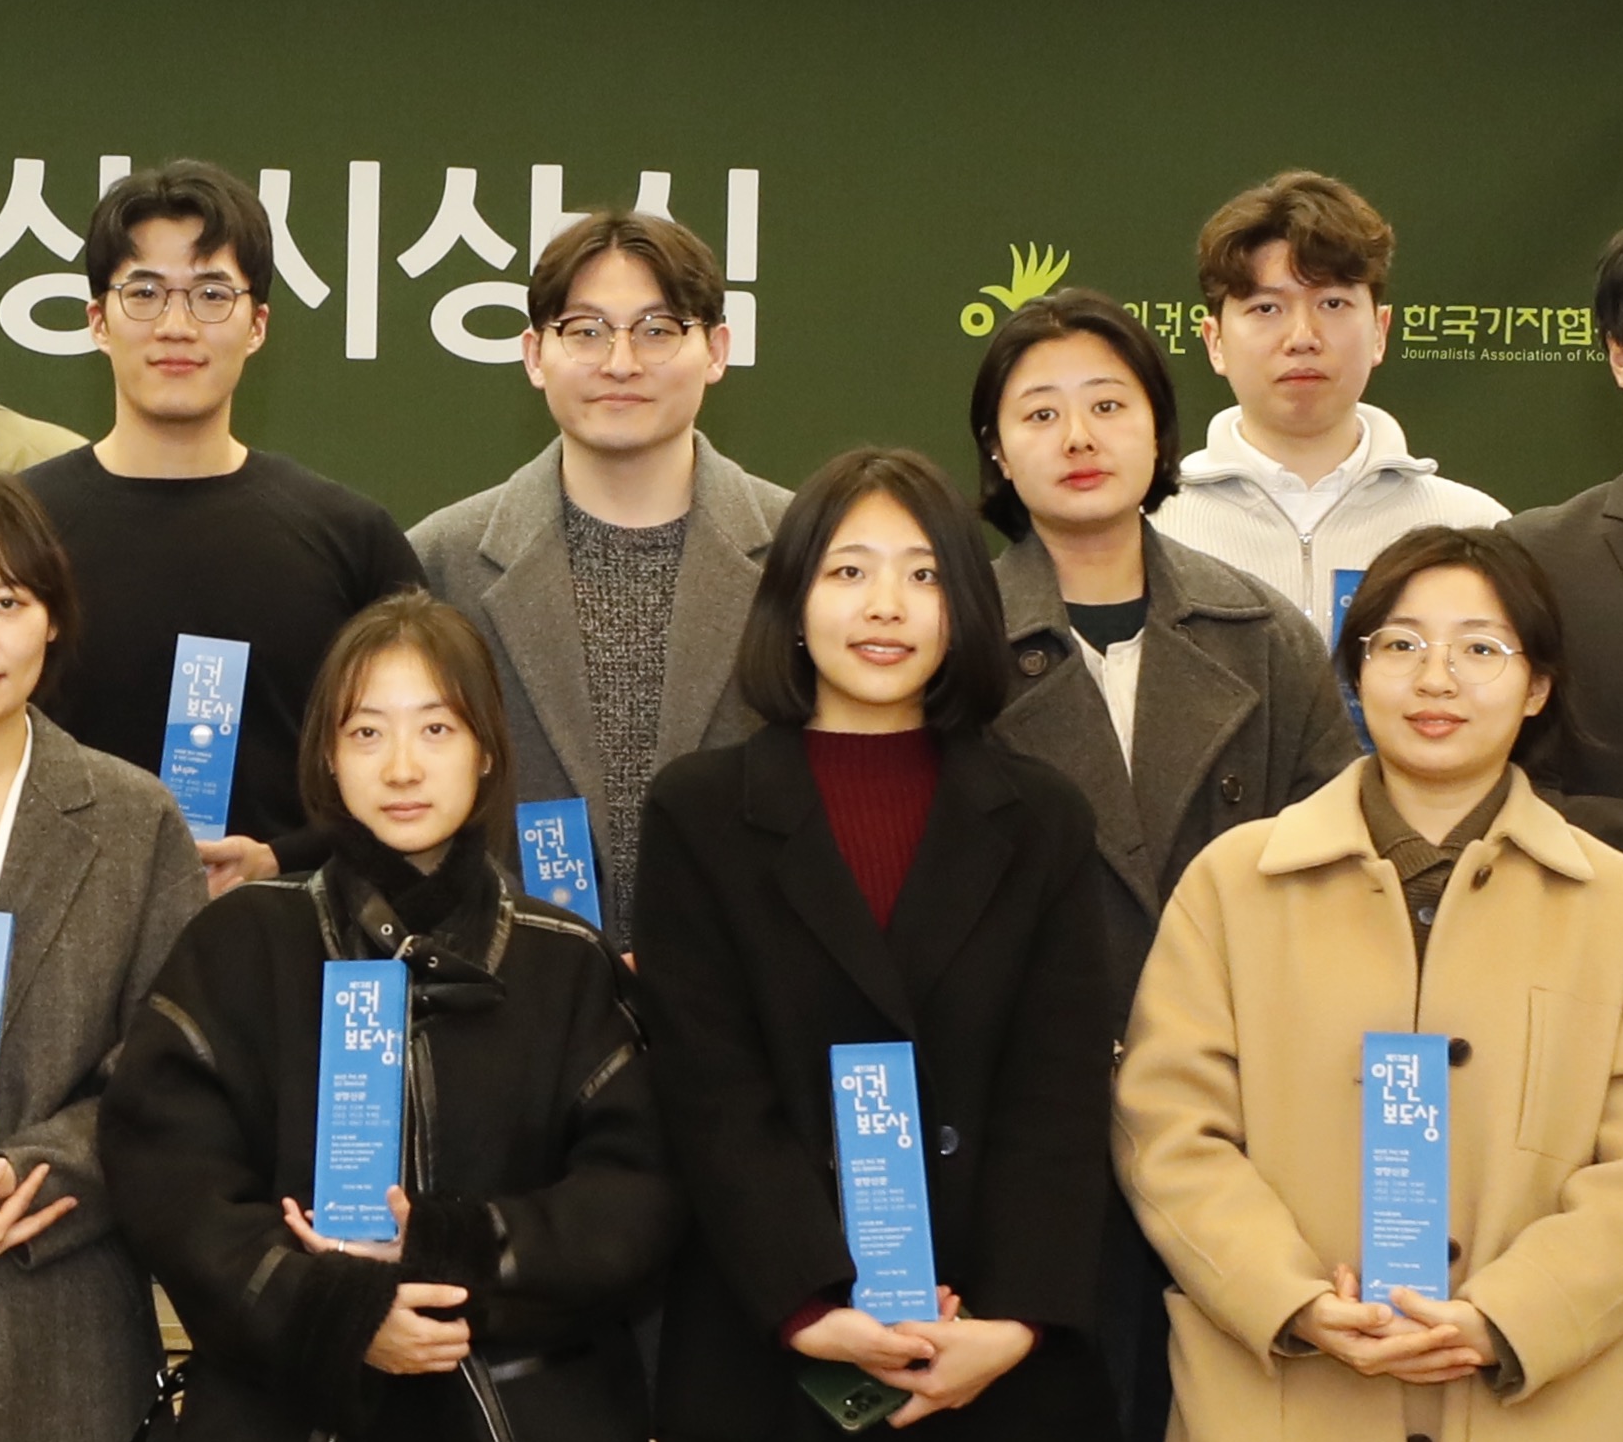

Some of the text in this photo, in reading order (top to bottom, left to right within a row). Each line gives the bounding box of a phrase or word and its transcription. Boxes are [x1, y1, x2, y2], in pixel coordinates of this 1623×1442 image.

[1402, 304, 1599, 346] 한국기자협
[1402, 347, 1608, 362] Journalists Association of Ko
[182, 656, 224, 699] 인권
[187, 698, 234, 736] 보도상
[524, 816, 569, 861] 인권
[539, 859, 588, 891] 보도상
[335, 980, 380, 1028] 인권
[344, 1029, 396, 1066] 보도상
[841, 1064, 892, 1112] 인권
[1371, 1054, 1421, 1102] 인권
[856, 1112, 913, 1149] 보도상
[1383, 1104, 1440, 1142] 보도상
